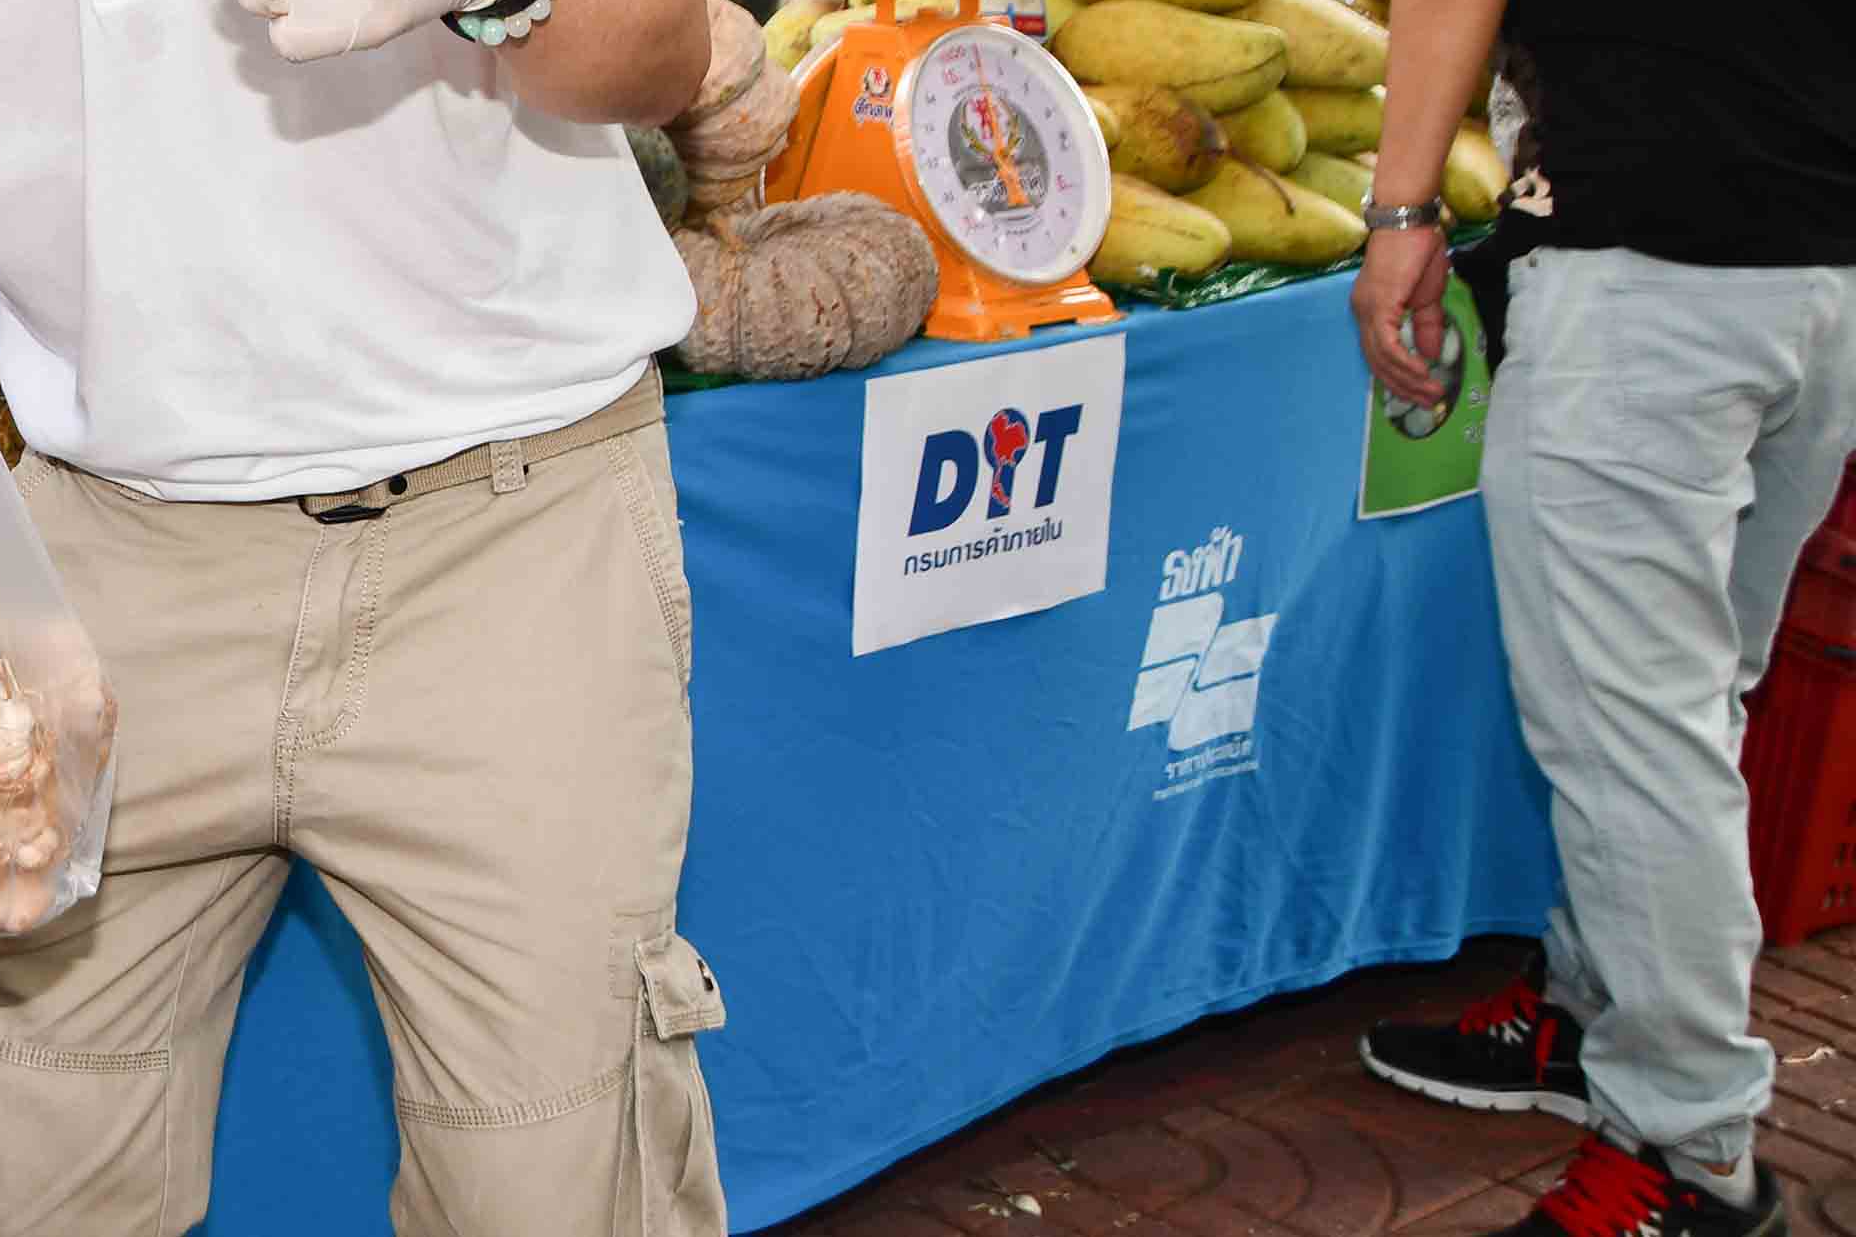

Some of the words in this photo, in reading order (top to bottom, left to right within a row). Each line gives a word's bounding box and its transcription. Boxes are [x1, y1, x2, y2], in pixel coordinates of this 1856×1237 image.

[907, 402, 1084, 536] DIT
[902, 516, 1064, 577] กรมการค้าภายใน
[1159, 523, 1245, 602] ธงฟ้า
